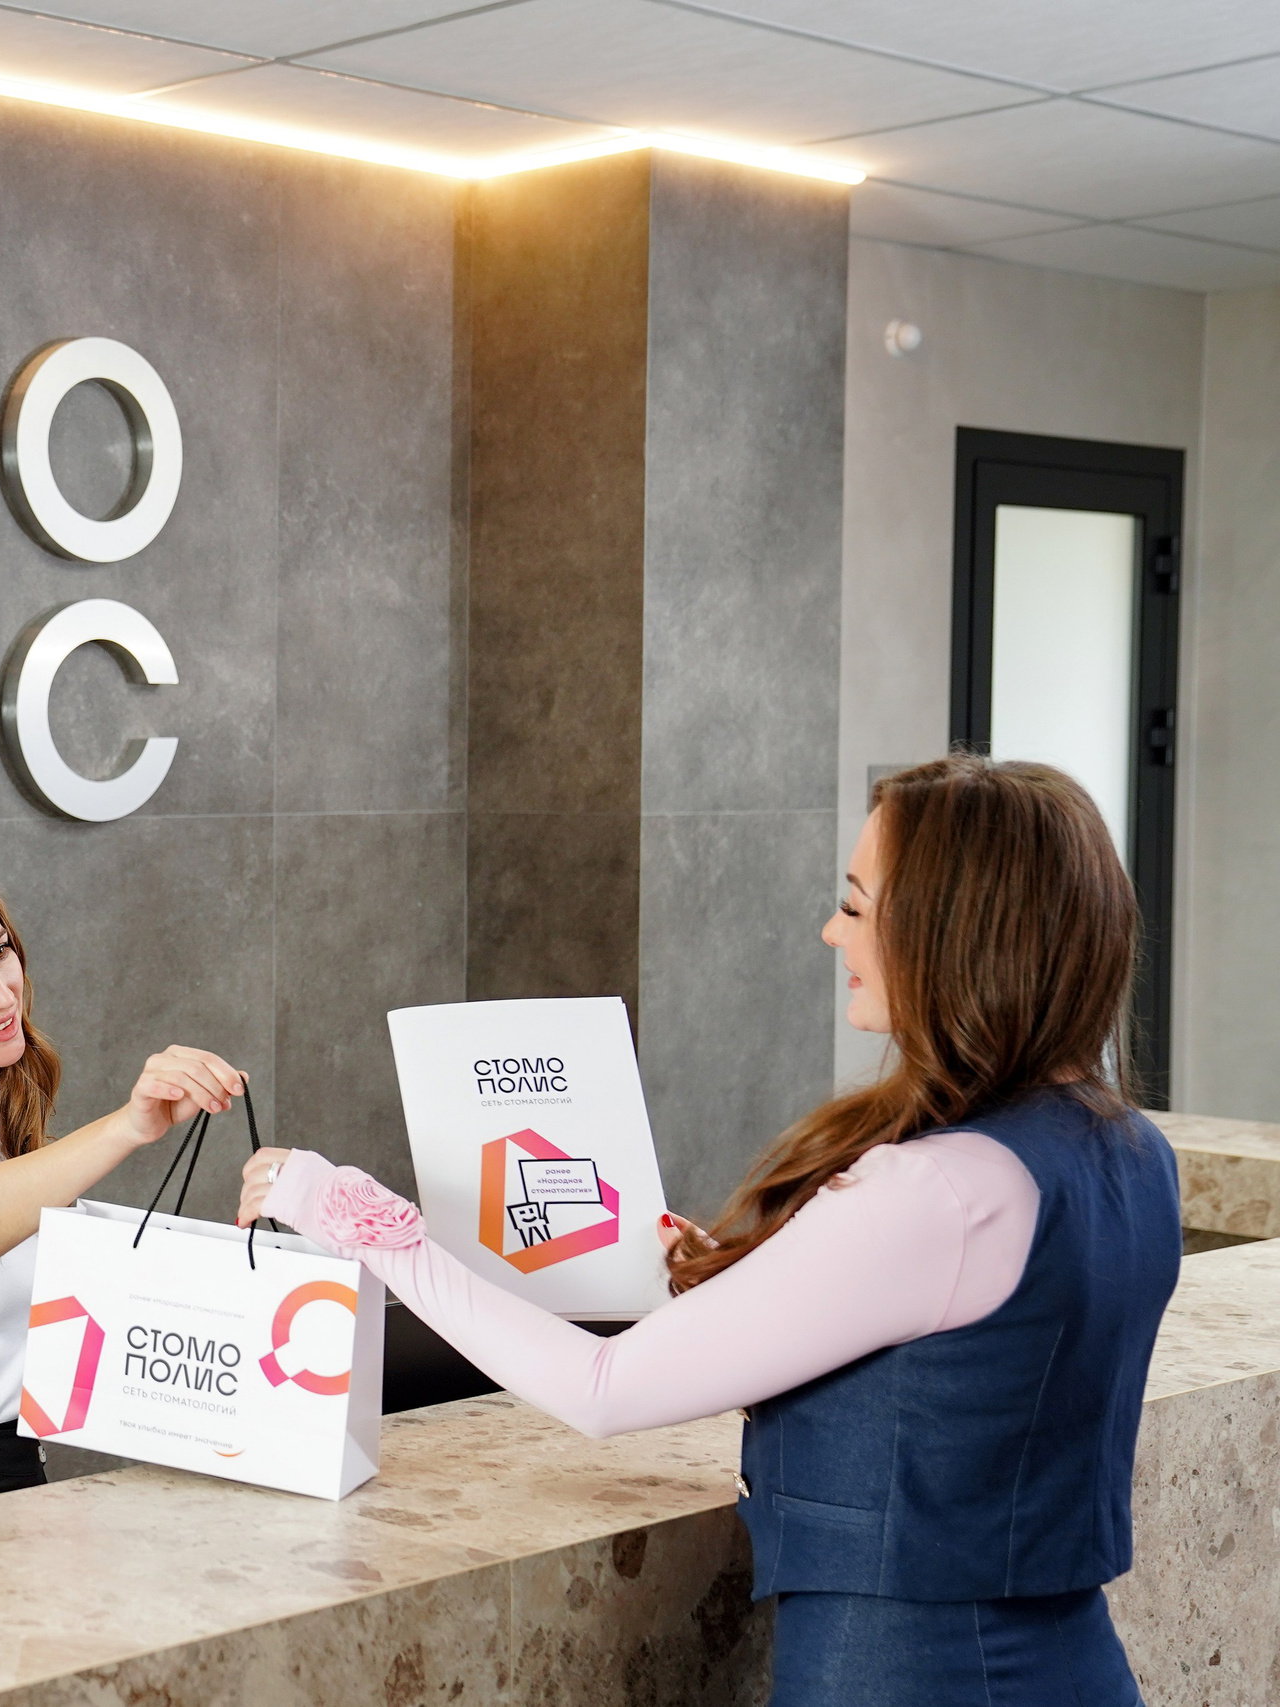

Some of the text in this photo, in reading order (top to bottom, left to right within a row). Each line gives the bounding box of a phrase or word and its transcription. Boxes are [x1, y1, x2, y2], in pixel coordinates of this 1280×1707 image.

[473, 1057, 564, 1076] СТОМО
[477, 1076, 568, 1095] ПОЛИС
[504, 1096, 573, 1106] СТОМАТОЛОГИЙ
[127, 1325, 241, 1368] СТОМО
[124, 1352, 238, 1396] ПОЛИС
[122, 1385, 237, 1416] СЕТЬ СТОМАТОЛОГИЙ
